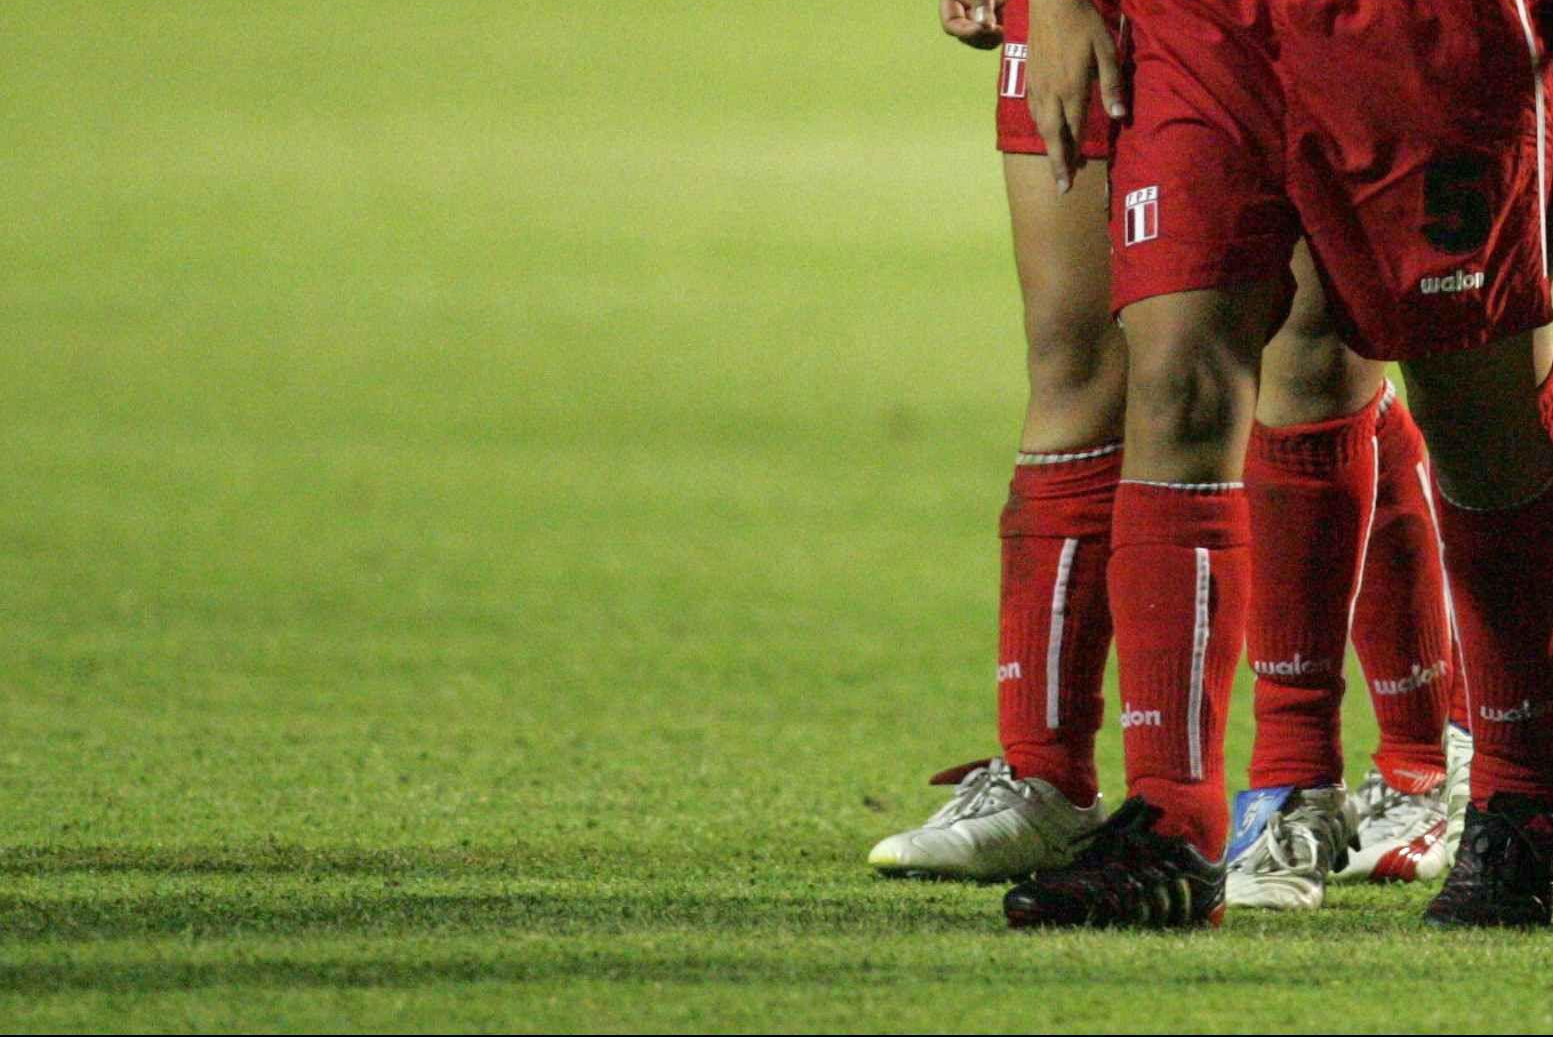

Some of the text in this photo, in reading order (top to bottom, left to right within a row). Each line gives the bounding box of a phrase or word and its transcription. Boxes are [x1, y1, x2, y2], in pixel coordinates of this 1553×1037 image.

[1420, 159, 1491, 255] 5
[1420, 269, 1485, 295] walon
[1120, 701, 1162, 728] alon
